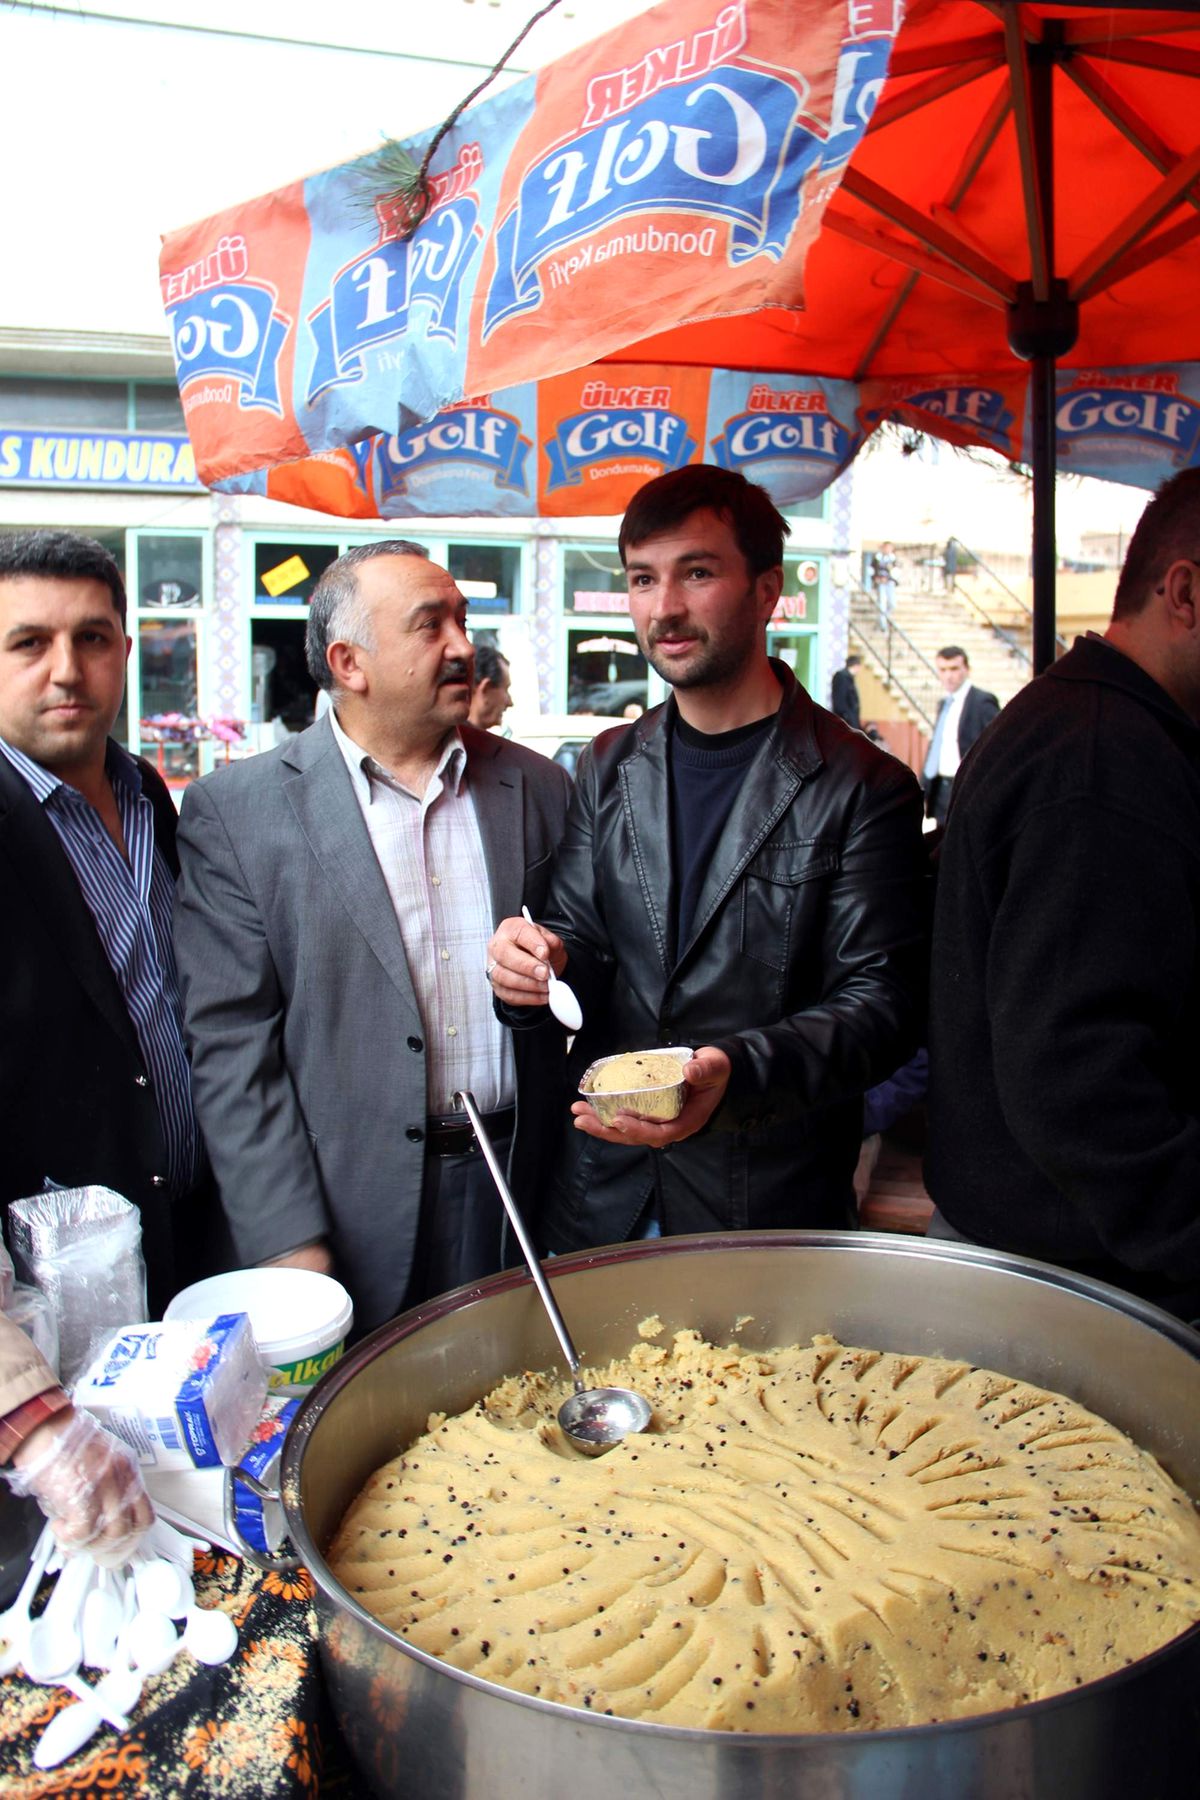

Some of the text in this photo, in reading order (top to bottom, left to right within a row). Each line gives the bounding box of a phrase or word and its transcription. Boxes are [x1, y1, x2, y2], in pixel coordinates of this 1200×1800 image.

[581, 381, 671, 410] ÜLKER
[748, 385, 829, 414] ÜLKER
[1055, 392, 1191, 441] Golf
[388, 412, 507, 464] Golf
[566, 412, 679, 457] Golf
[731, 416, 838, 456] Golf
[29, 437, 196, 483] KUNDURA
